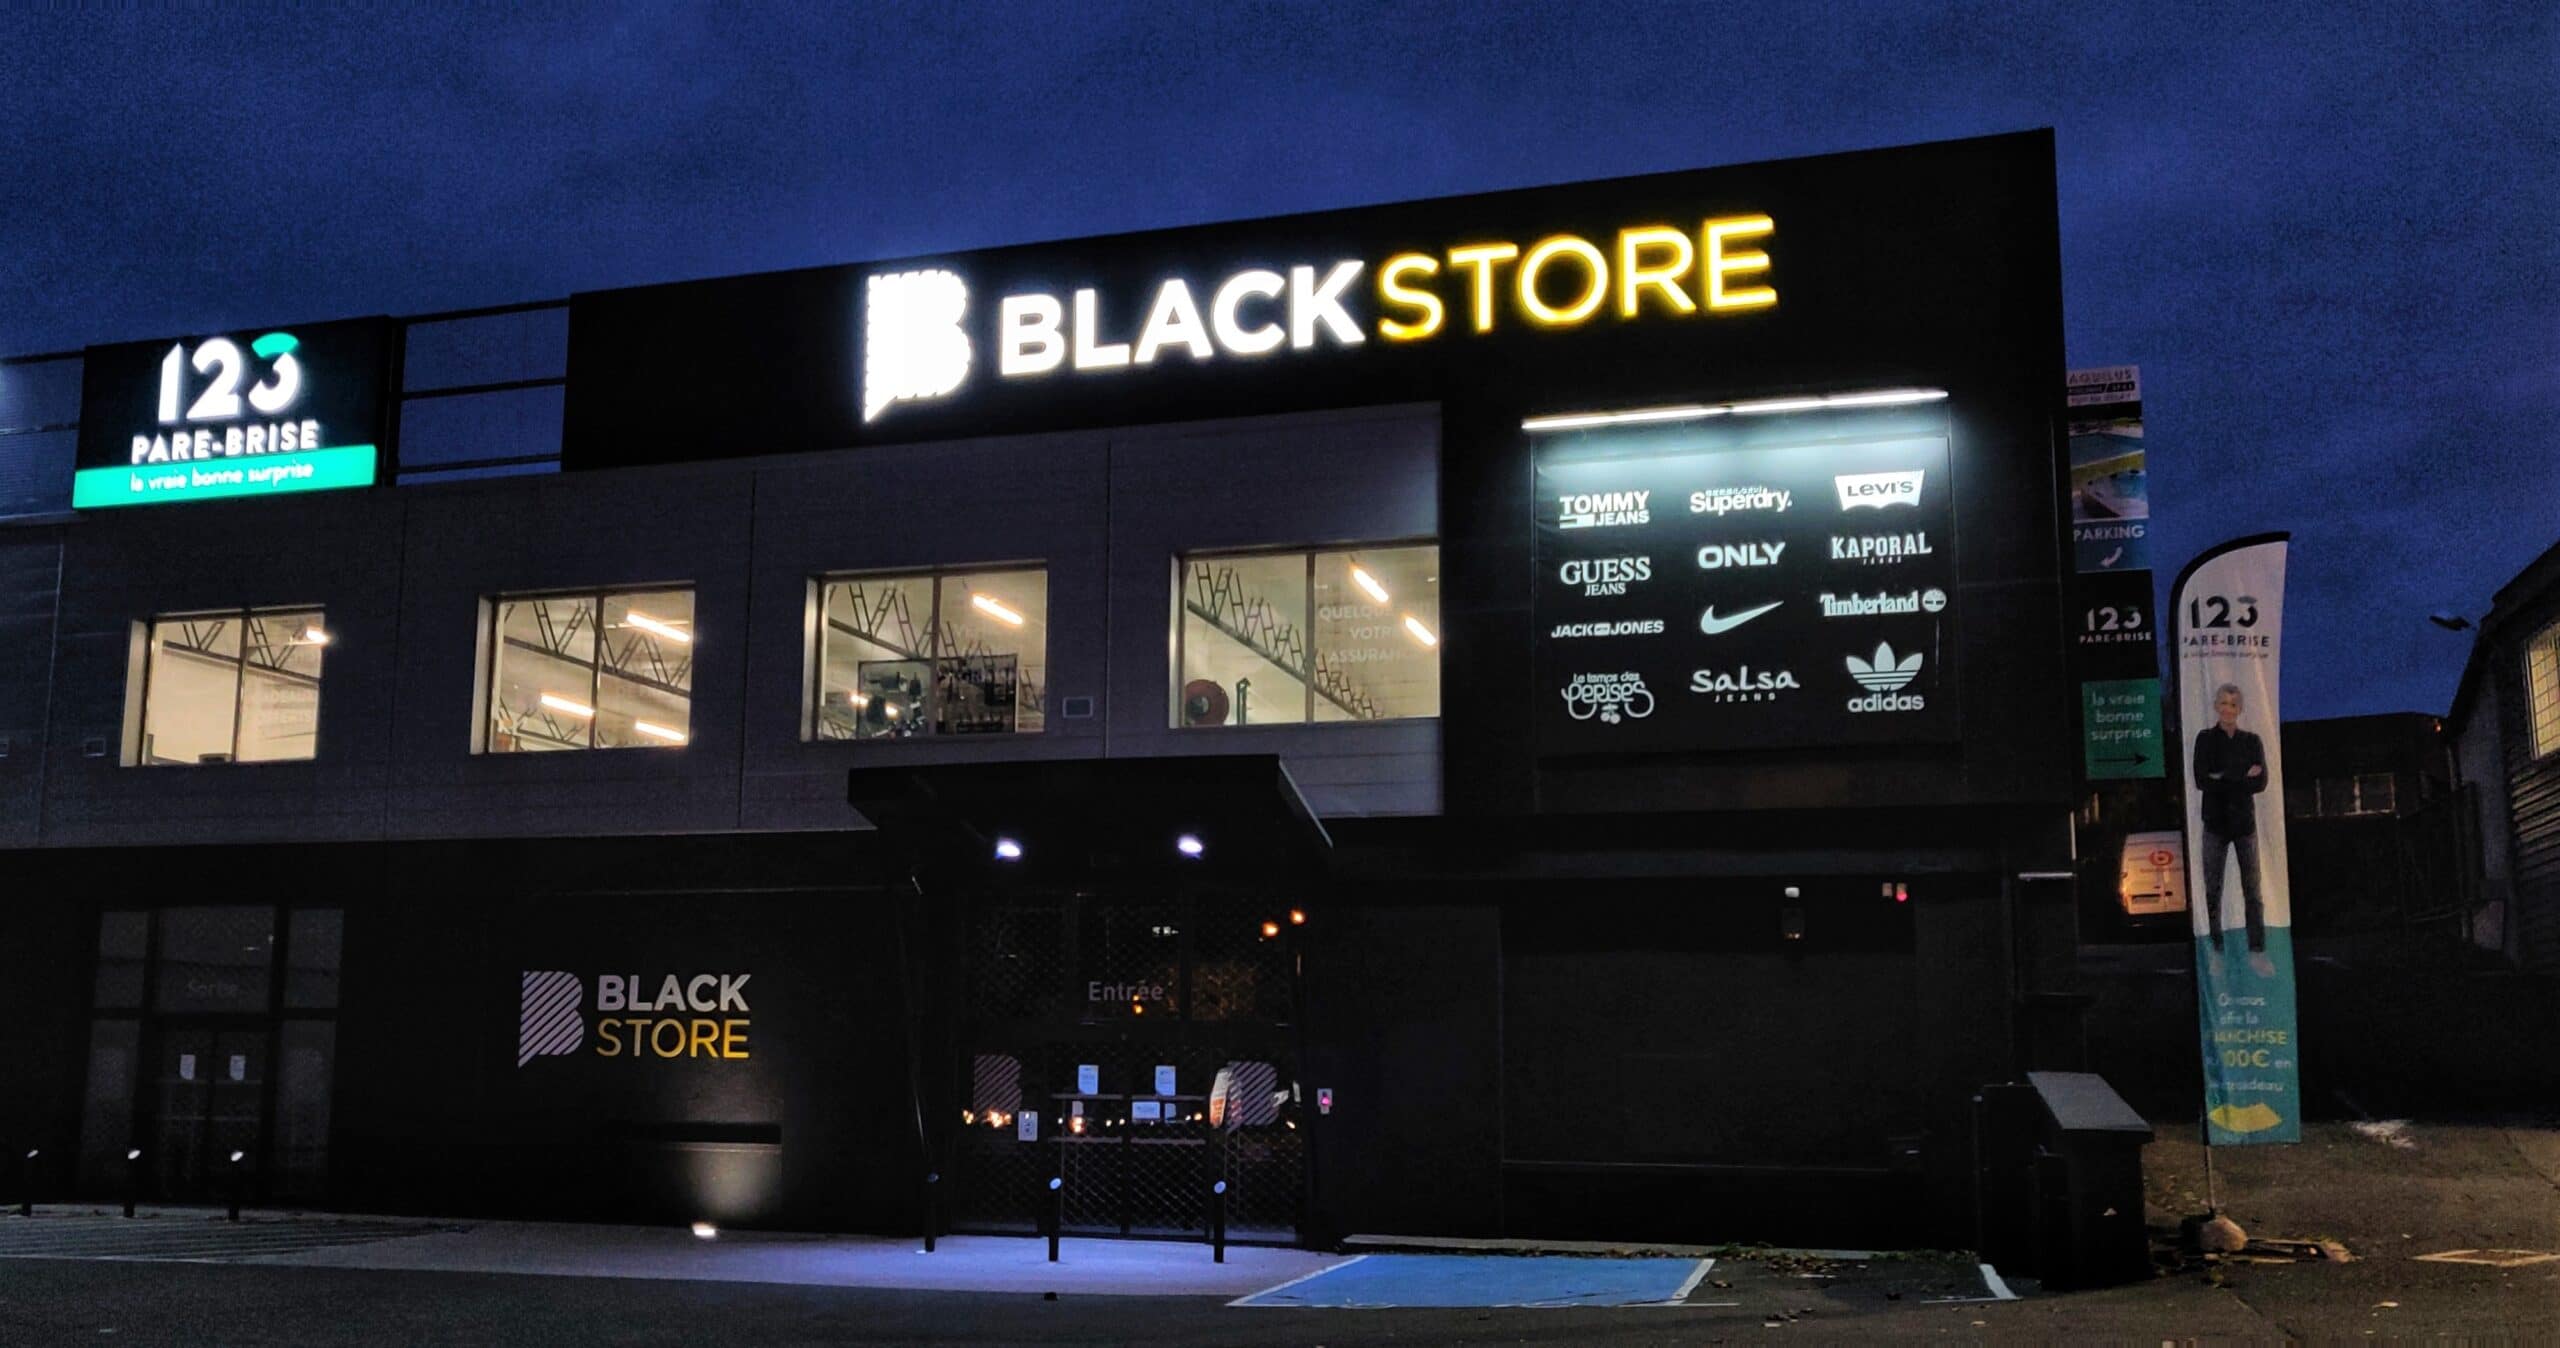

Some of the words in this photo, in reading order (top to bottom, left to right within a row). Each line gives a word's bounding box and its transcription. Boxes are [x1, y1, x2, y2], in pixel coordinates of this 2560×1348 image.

[158, 333, 301, 424] 123
[131, 419, 321, 466] PARE-BRISE
[148, 468, 188, 490] vraie
[191, 466, 244, 488] bonne
[249, 458, 315, 488] surprise
[1559, 490, 1650, 516] TOMMY
[1596, 510, 1650, 526] JEANS
[1831, 531, 1933, 559] KAPORAL
[2073, 523, 2146, 543] PARKING
[1698, 541, 1786, 569] ONLY
[1560, 556, 1652, 585] GUESS
[1584, 582, 1627, 597] JEANS
[1820, 590, 1920, 617] Timberland
[2191, 595, 2259, 630] 123
[2087, 605, 2143, 632] 123
[2078, 631, 2153, 645] PARE-BRISE
[1690, 665, 1801, 693] Salsa
[1715, 692, 1776, 704] JEANS
[1848, 693, 1926, 713] adidas
[2095, 708, 2145, 723] bonne
[2090, 728, 2153, 745] surprise
[597, 973, 751, 1012] BLACK
[1088, 979, 1165, 1001] Entrée
[596, 1017, 751, 1059] STORE
